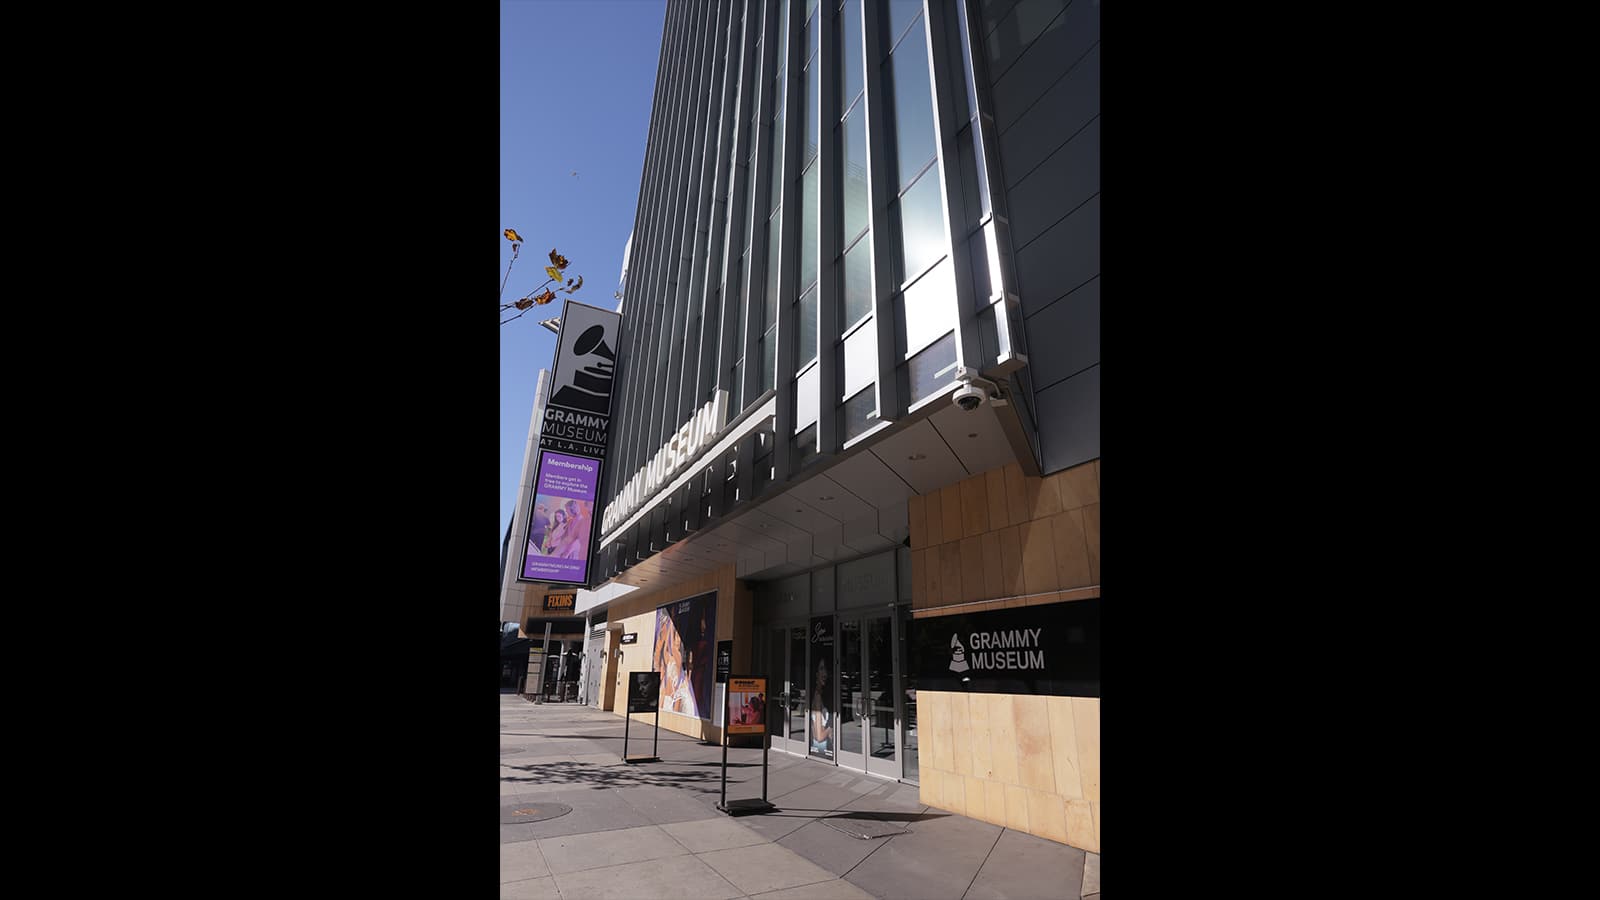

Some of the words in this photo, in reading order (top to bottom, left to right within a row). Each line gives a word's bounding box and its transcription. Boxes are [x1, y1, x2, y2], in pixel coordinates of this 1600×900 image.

[545, 409, 609, 430] GRAMMY
[542, 421, 607, 443] MUSEUM
[540, 438, 552, 447] AT
[558, 441, 579, 451] L.A.
[583, 446, 605, 455] LIVE
[547, 458, 593, 472] Membership
[601, 466, 647, 535] GRAMMY
[644, 389, 729, 496] MUSEUM
[547, 594, 573, 607] FIXINS
[970, 628, 1041, 650] GRAMMY
[971, 650, 1045, 670] MUSEUM
